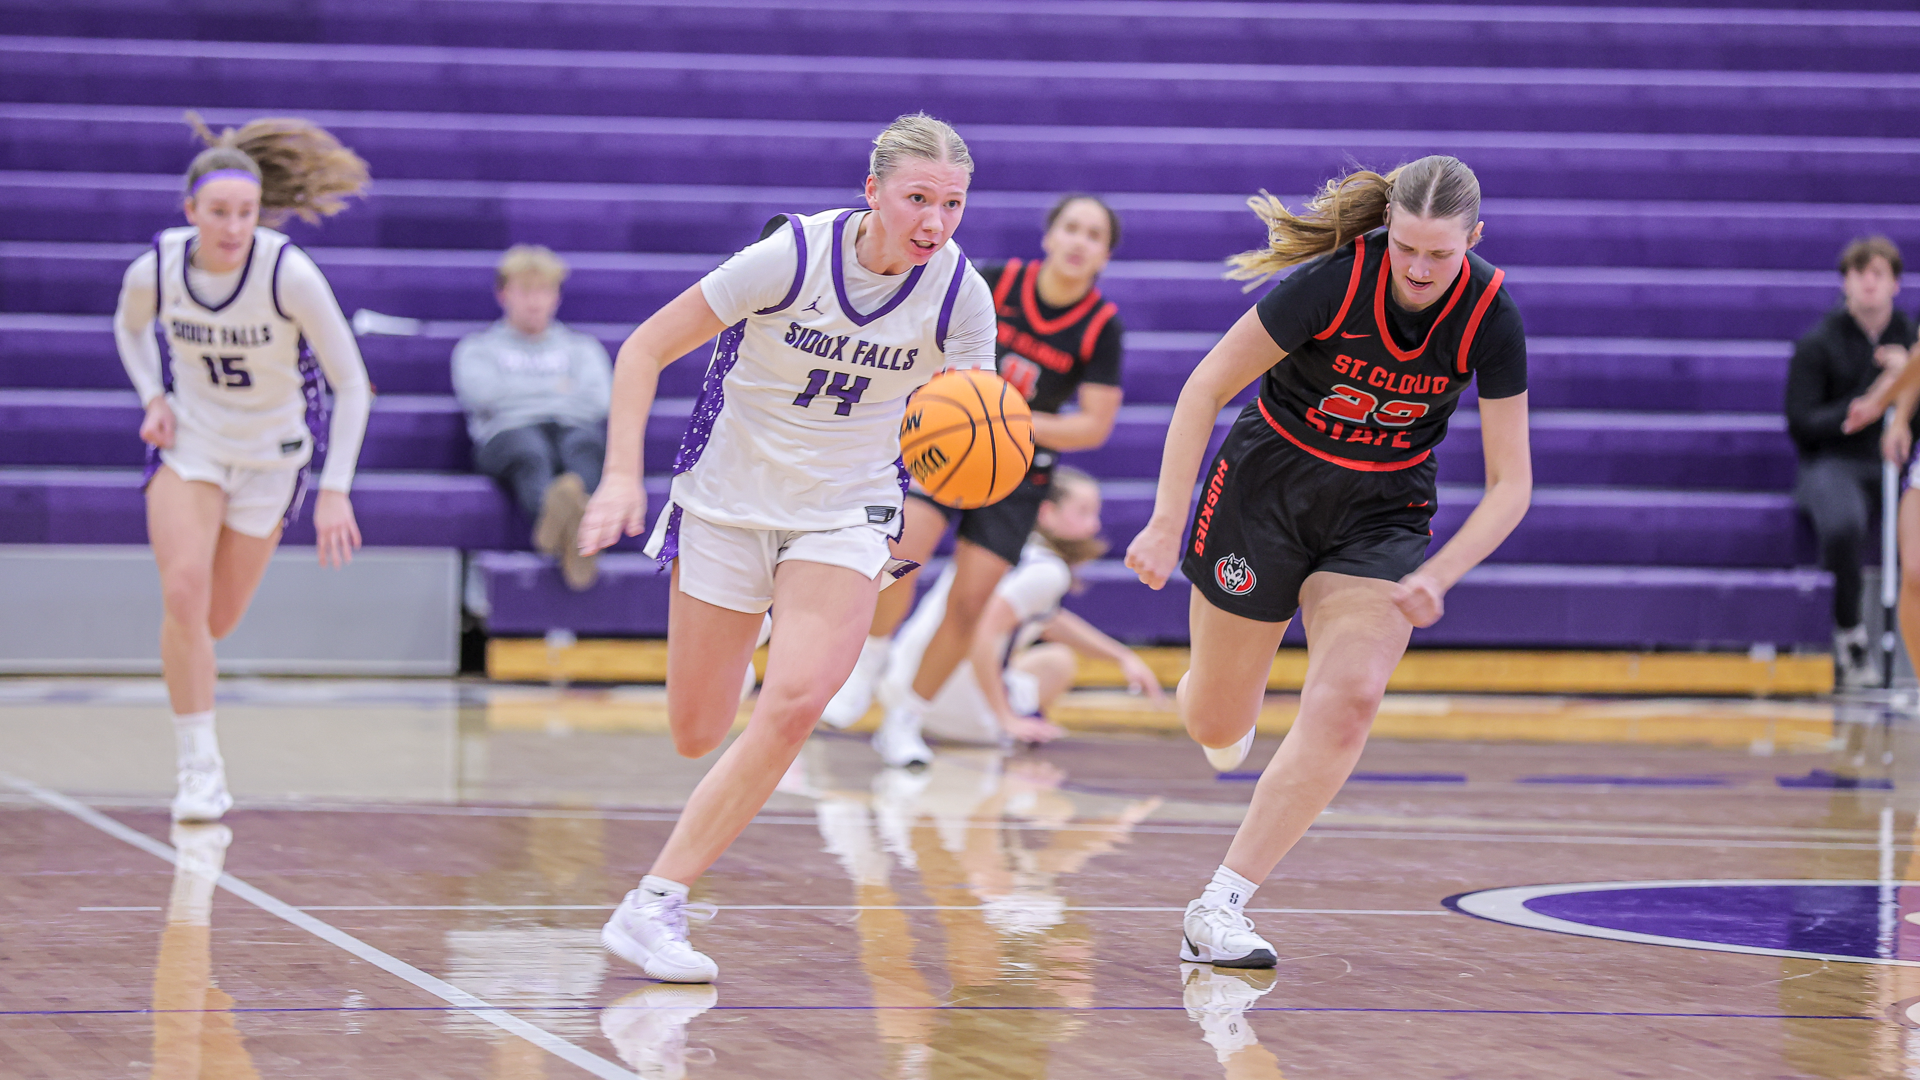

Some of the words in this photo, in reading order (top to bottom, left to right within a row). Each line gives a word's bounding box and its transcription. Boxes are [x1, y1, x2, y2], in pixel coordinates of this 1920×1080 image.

[172, 319, 214, 346] SIOUX
[220, 325, 272, 347] FALLS
[784, 321, 851, 361] SIOUX
[851, 339, 919, 371] FALLS
[202, 355, 251, 387] 15
[791, 368, 872, 416] 14
[1331, 353, 1368, 380] ST.
[1367, 365, 1449, 395] CLOUD
[1194, 458, 1229, 557] HUSKIES
